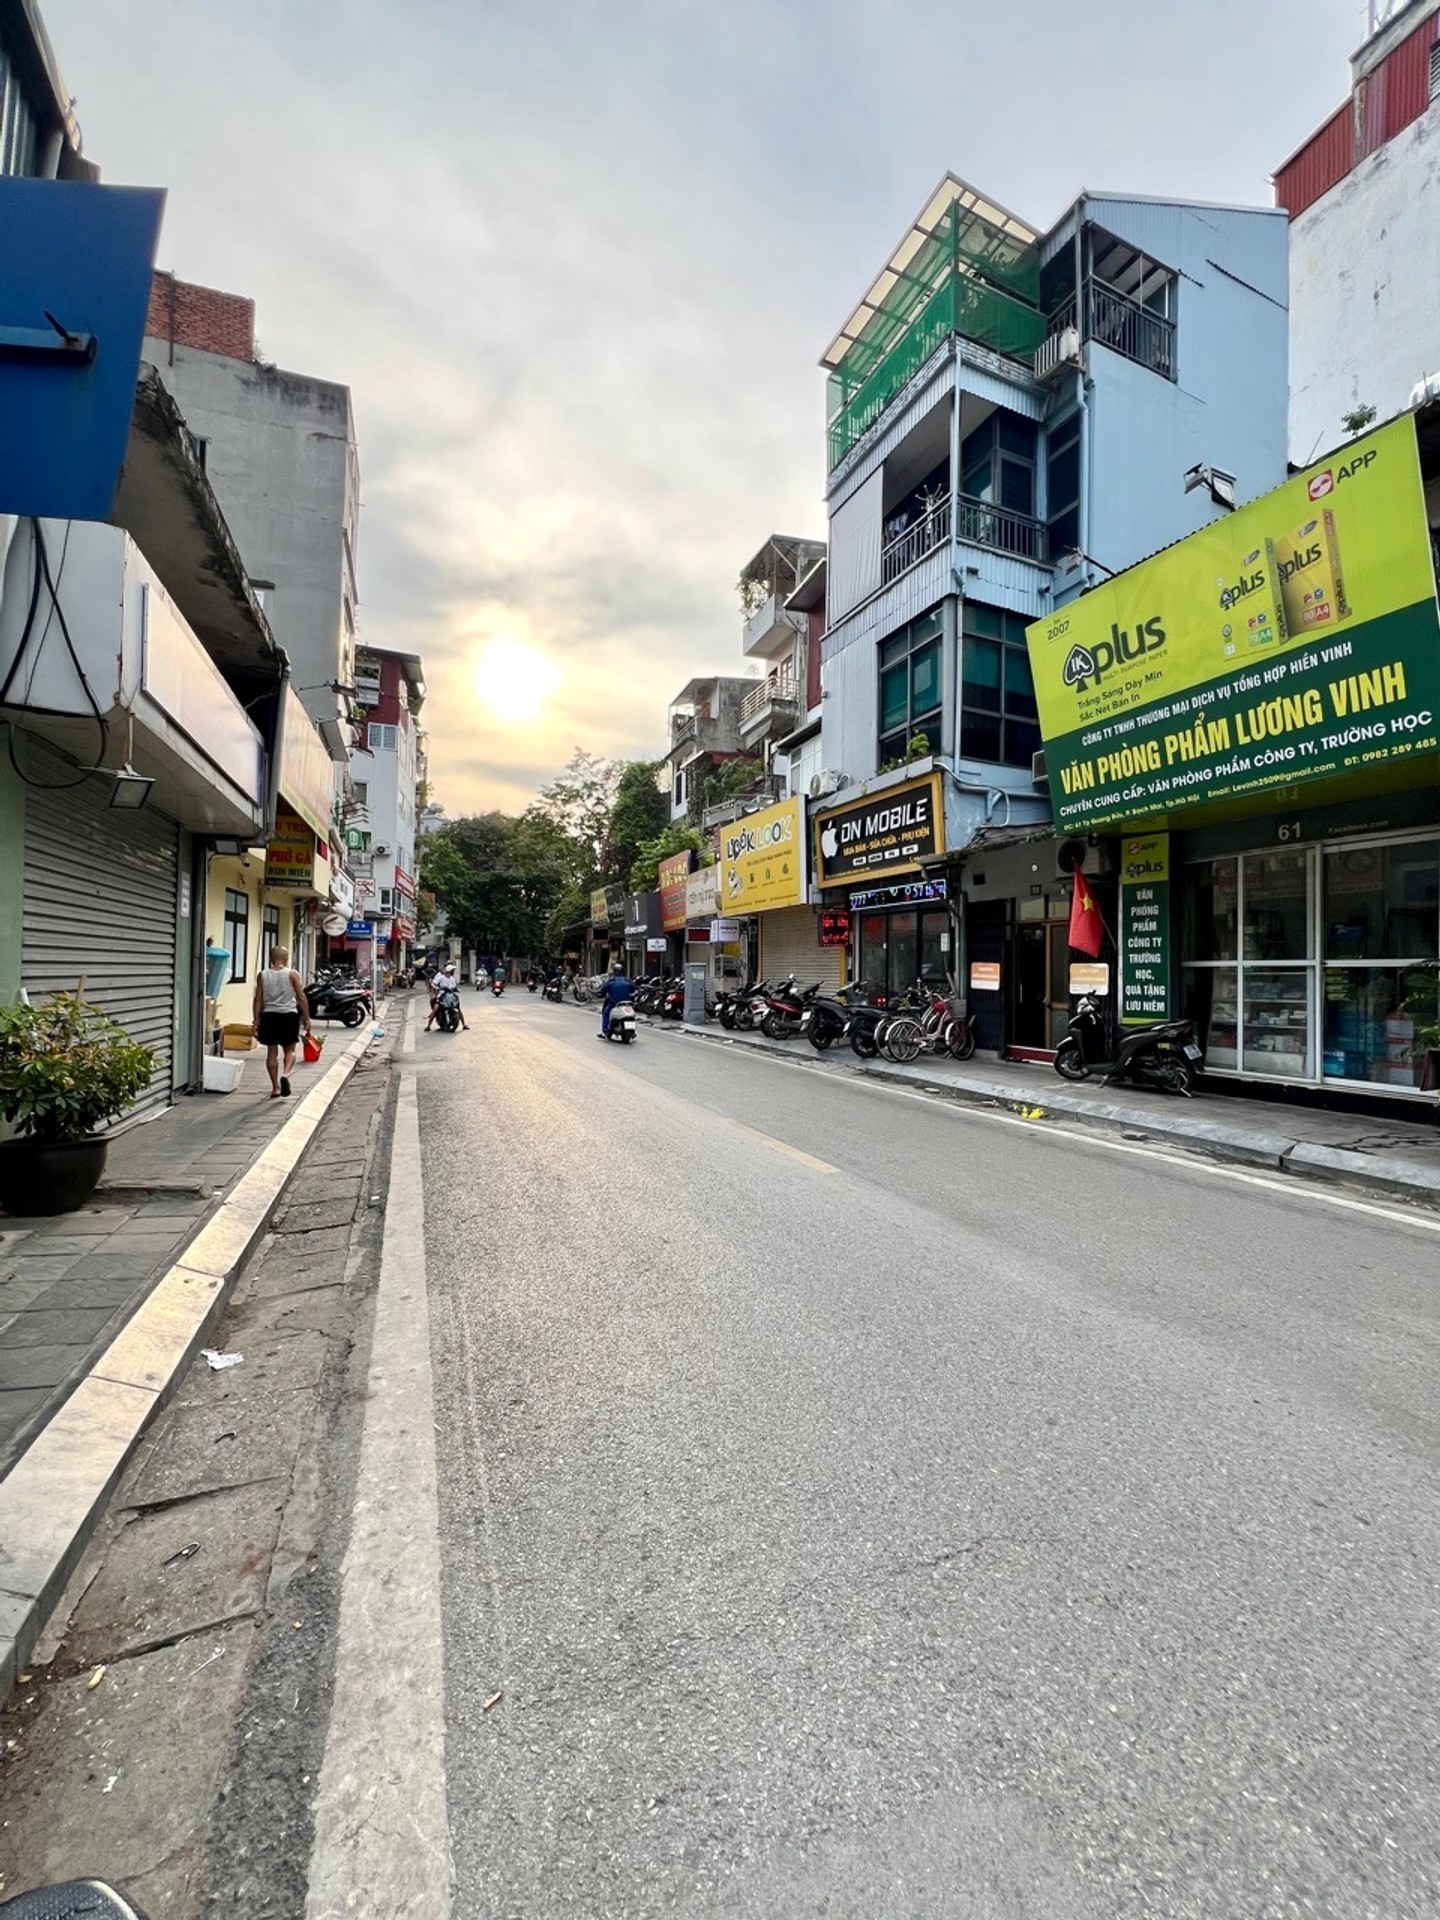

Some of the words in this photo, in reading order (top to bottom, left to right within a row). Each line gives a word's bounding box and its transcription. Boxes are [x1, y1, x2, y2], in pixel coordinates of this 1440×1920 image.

[1337, 450, 1377, 483] APP
[1284, 543, 1322, 582] plus
[1231, 570, 1265, 607] plus
[1047, 621, 1070, 640] 2007
[1089, 616, 1166, 685] plus
[1082, 730, 1102, 746] CÔNG
[1103, 727, 1113, 739] TY
[1113, 719, 1135, 735] TNHH
[1172, 700, 1190, 715] MẠI
[1191, 692, 1215, 709] DỊCH
[1217, 684, 1231, 700] VỤ
[1263, 665, 1287, 683] HỢP
[1321, 641, 1353, 663] VINH
[1131, 693, 1140, 701] In
[1060, 759, 1095, 795] VĂN
[1097, 743, 1161, 785] PHÒNG
[1164, 712, 1231, 765] PHẨM
[1235, 689, 1323, 746] LƯƠNG
[1328, 661, 1407, 718] VINH
[1060, 799, 1092, 817] CHUYÊN
[1094, 792, 1120, 808] CUNG
[1122, 783, 1147, 800] CẤP:
[1148, 779, 1170, 794] VĂN
[1172, 768, 1213, 789] PHÒNG
[1215, 755, 1251, 777] PHẨM
[1254, 747, 1296, 767] CÔNG
[1298, 741, 1319, 756] TY,
[1321, 723, 1386, 750] TRƯỜNG
[1391, 710, 1433, 733] HỌC
[1362, 749, 1388, 761] 0982
[841, 819, 862, 843] DN
[865, 798, 928, 837] MOBILE
[1278, 822, 1300, 840] 61
[1137, 860, 1164, 877] plus
[1128, 936, 1150, 948] CÔNG
[1151, 937, 1162, 947] TY
